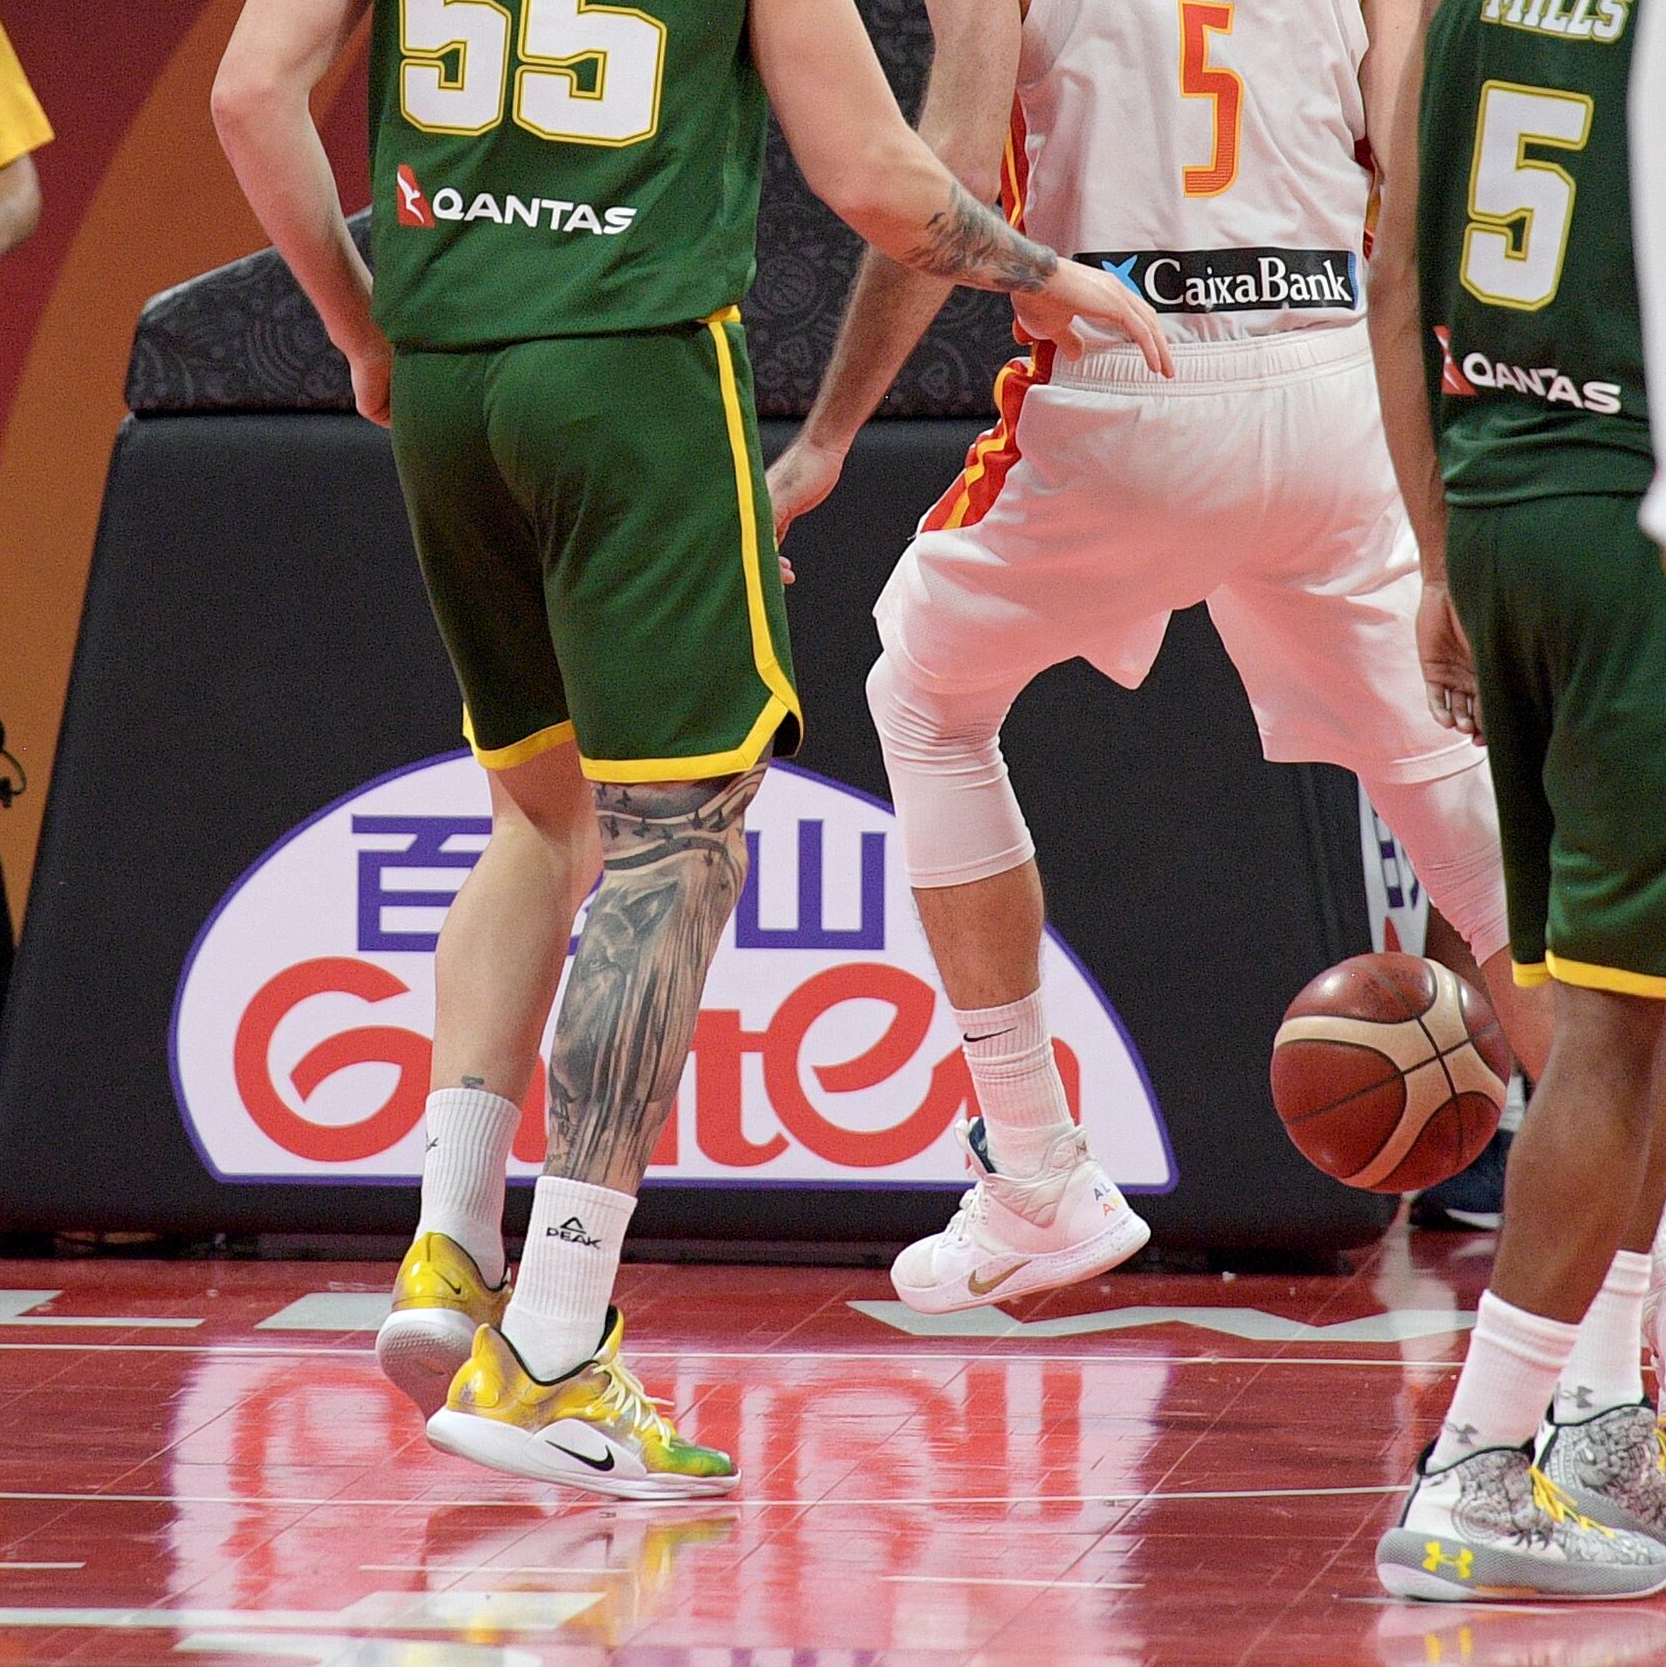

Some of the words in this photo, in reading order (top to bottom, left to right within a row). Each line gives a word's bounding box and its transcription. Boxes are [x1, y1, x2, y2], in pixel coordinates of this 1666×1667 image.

[432, 186, 637, 235] QANTAS
[1459, 79, 1595, 312] 5
[1143, 256, 1353, 311] CaixaBank
[351, 814, 887, 952] 百山
[232, 956, 1082, 1170] Gte
[546, 1227, 602, 1249] PEAK
